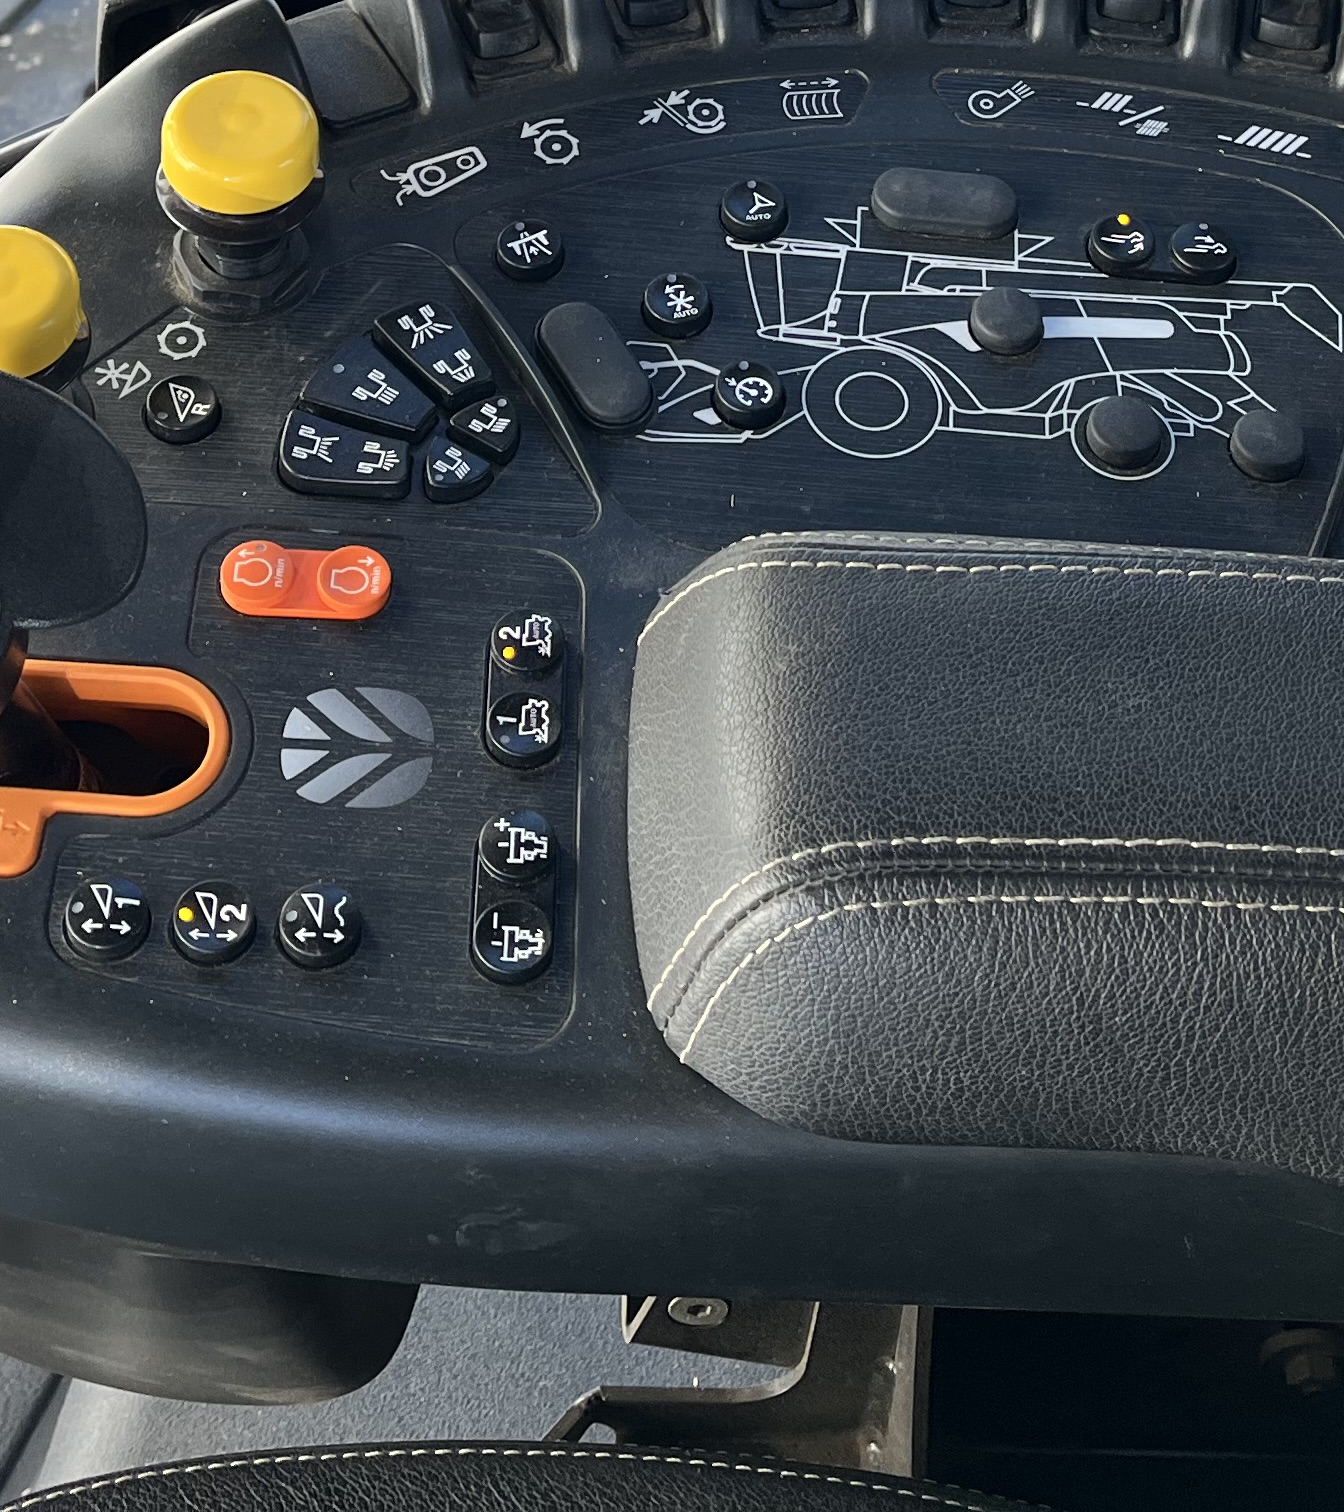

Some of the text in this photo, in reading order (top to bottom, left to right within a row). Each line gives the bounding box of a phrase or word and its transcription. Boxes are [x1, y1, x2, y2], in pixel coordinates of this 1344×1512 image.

[745, 212, 772, 221] AUTO
[673, 307, 699, 319] AUTO
[190, 402, 211, 416] R
[498, 625, 521, 640] 2
[219, 903, 248, 922] 2
